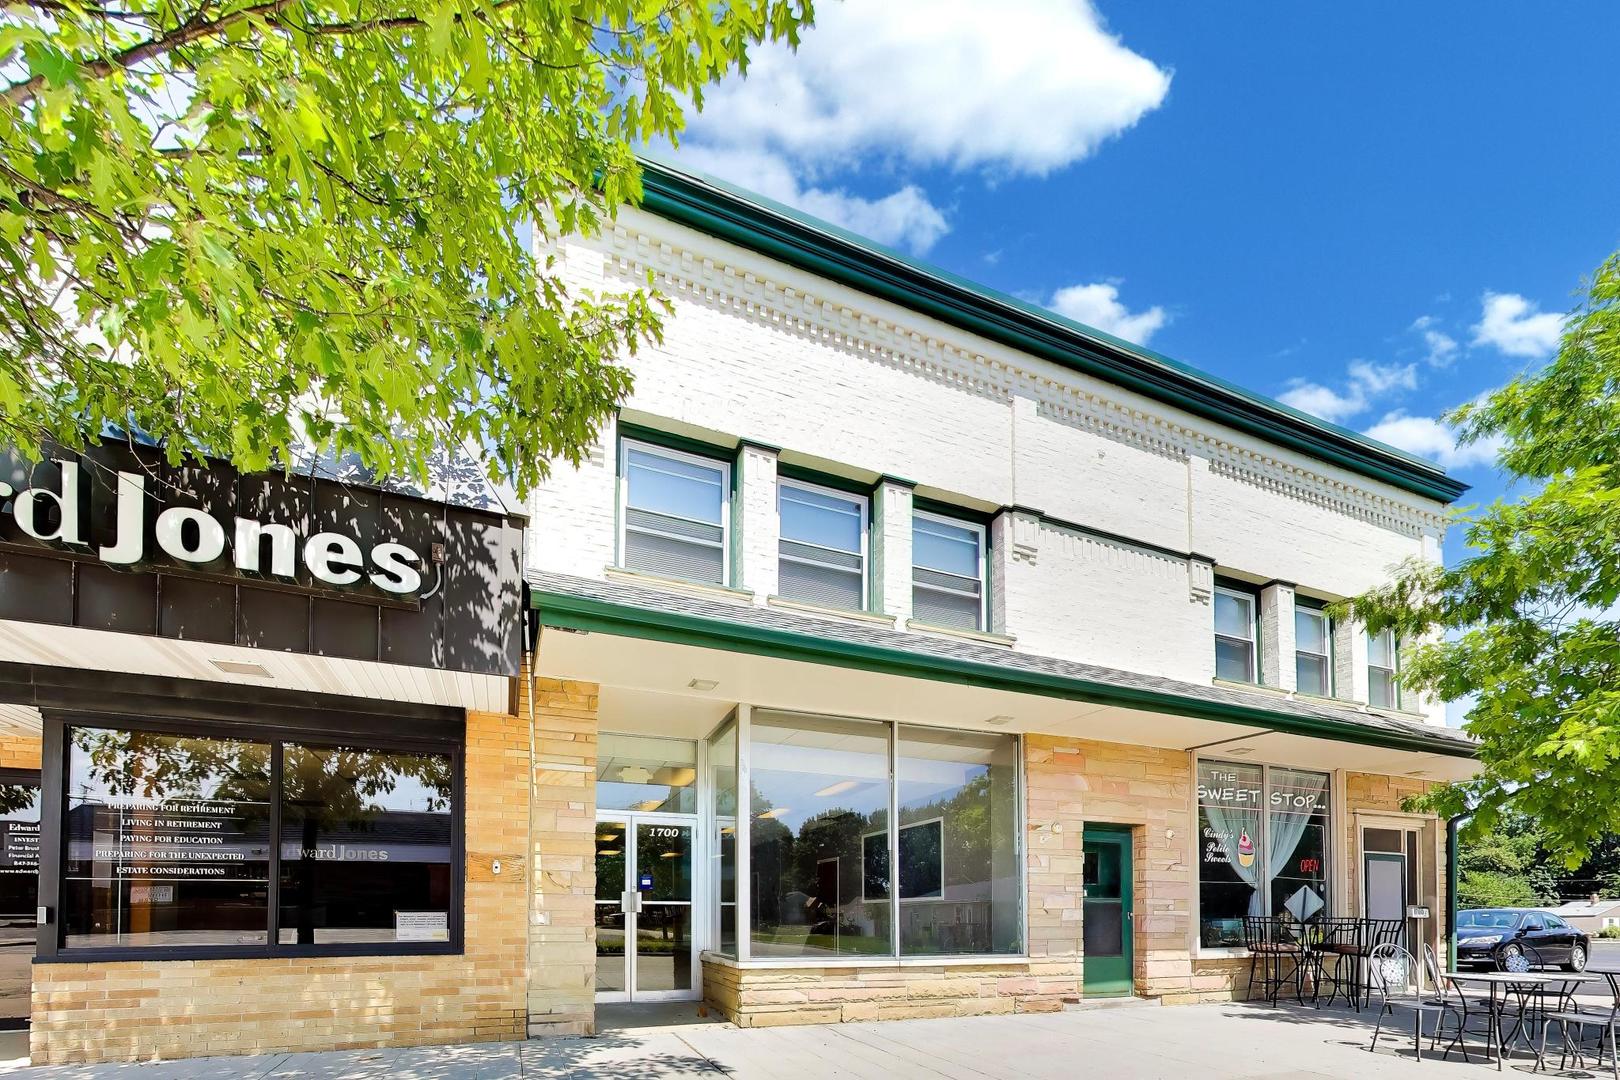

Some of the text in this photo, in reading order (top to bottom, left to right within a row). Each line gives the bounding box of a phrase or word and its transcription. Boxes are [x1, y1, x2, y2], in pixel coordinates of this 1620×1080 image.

[1210, 770, 1237, 783] THE
[1198, 785, 1261, 803] SWEET
[107, 802, 236, 815] PREPARING FOR RETIREMENT
[122, 818, 223, 830] LIVING IN RETIREMENT
[648, 828, 679, 837] 1700
[1203, 827, 1234, 842] Cindy's
[120, 834, 224, 845] PAYING FOR EDUCATION
[95, 850, 245, 861] PREPARING FOR THE UNEXPECTED
[116, 866, 226, 876] ESTATE CONSIDERATIONS
[1300, 859, 1319, 873] OPEN
